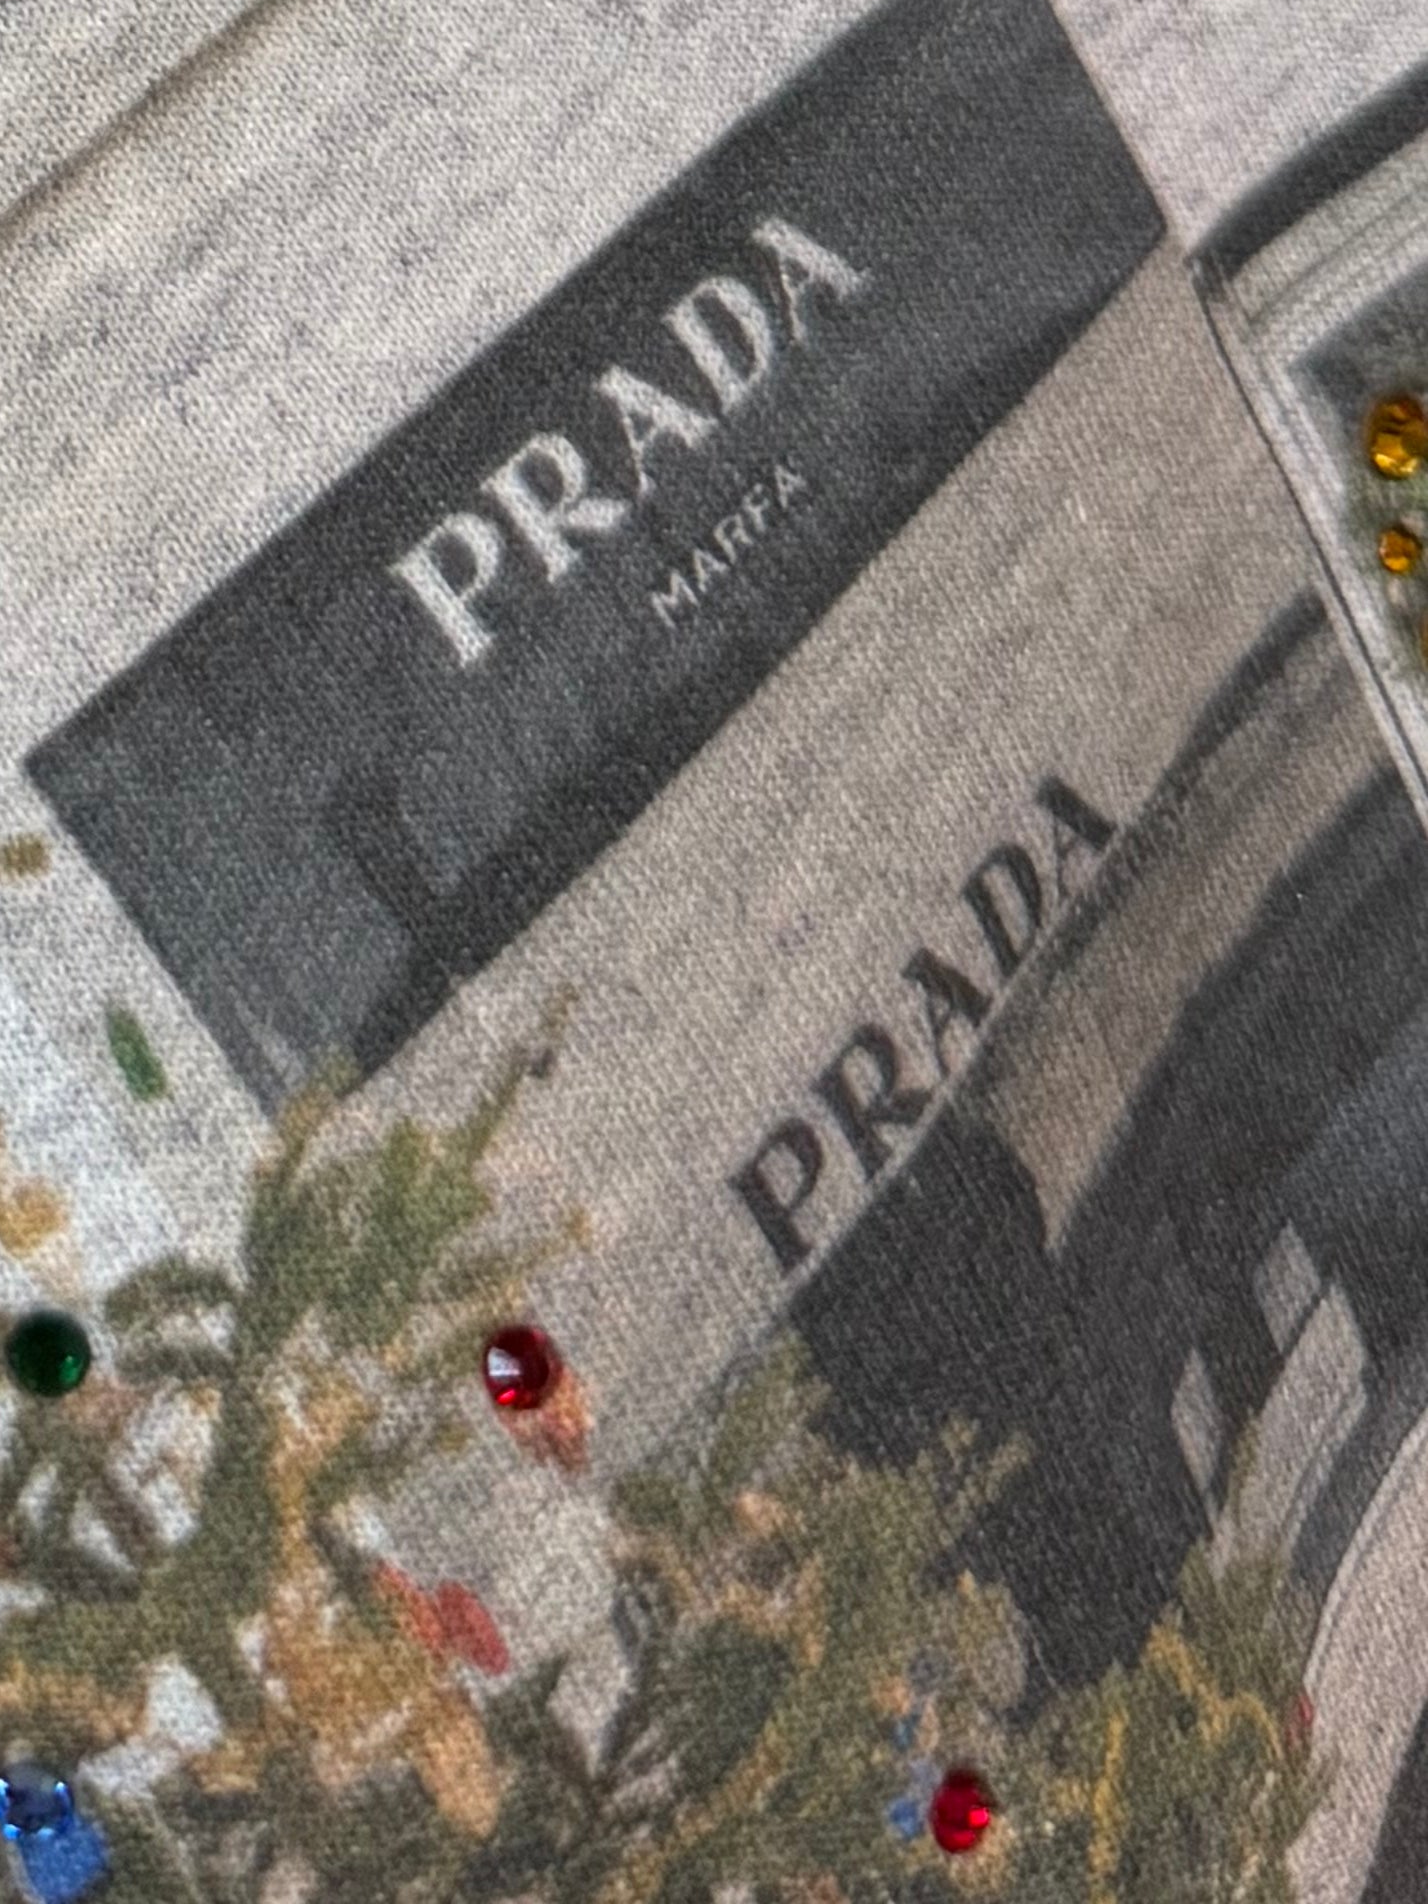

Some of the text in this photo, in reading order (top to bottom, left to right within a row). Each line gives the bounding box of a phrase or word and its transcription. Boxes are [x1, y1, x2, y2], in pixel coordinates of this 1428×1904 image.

[387, 216, 869, 668] PRADA
[650, 462, 808, 629] MARFA
[726, 775, 1118, 1280] PRADA
